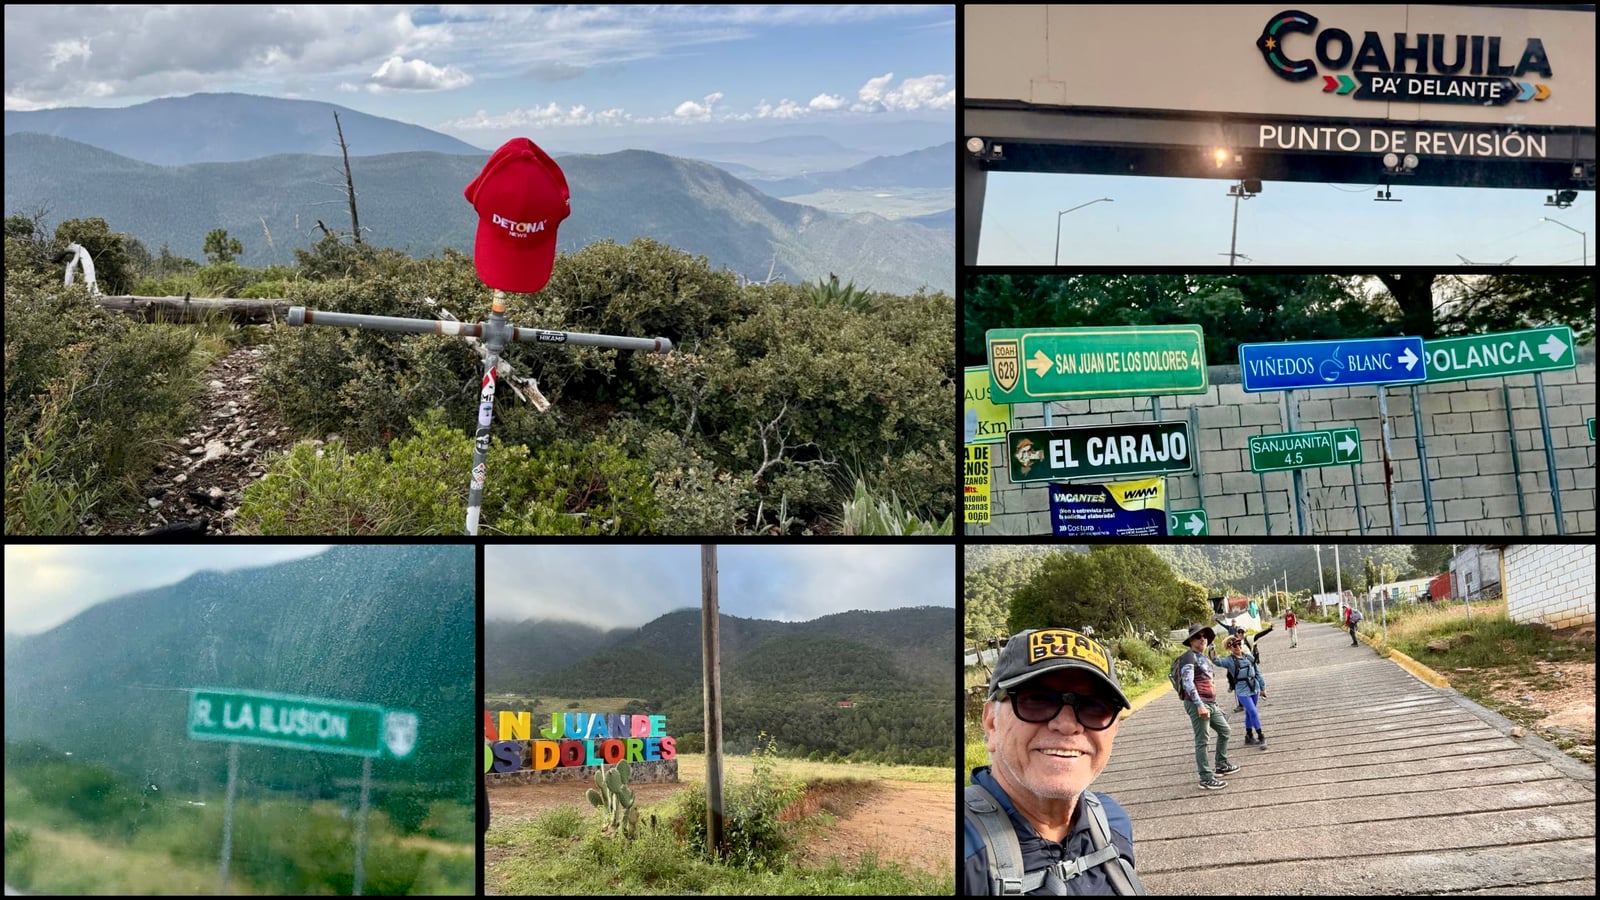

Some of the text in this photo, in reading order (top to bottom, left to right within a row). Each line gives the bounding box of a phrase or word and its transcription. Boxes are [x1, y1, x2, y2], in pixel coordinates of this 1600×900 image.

[1256, 10, 1552, 82] COAHUILA
[1408, 79, 1501, 98] DELANTE
[1259, 125, 1547, 158] PUNTO DE REVISIÓN
[995, 346, 1015, 356] COAH
[998, 361, 1015, 380] 628
[1055, 349, 1200, 375] SAN JUAN DE LOS DOLORES 4
[1249, 352, 1393, 377] VIÑEDOS BLANC
[978, 420, 1007, 436] Km
[974, 446, 988, 460] DE
[1049, 431, 1187, 469] EL CARAJO
[1253, 436, 1330, 454] SANJUANITA
[1284, 452, 1303, 465] 4.5
[1054, 493, 1106, 503] VACANTES
[1067, 524, 1095, 532] Costura
[1033, 633, 1105, 660] ISTAN
[1034, 644, 1085, 659] BUL
[222, 702, 255, 730] LA
[531, 736, 676, 771] DOLORES
